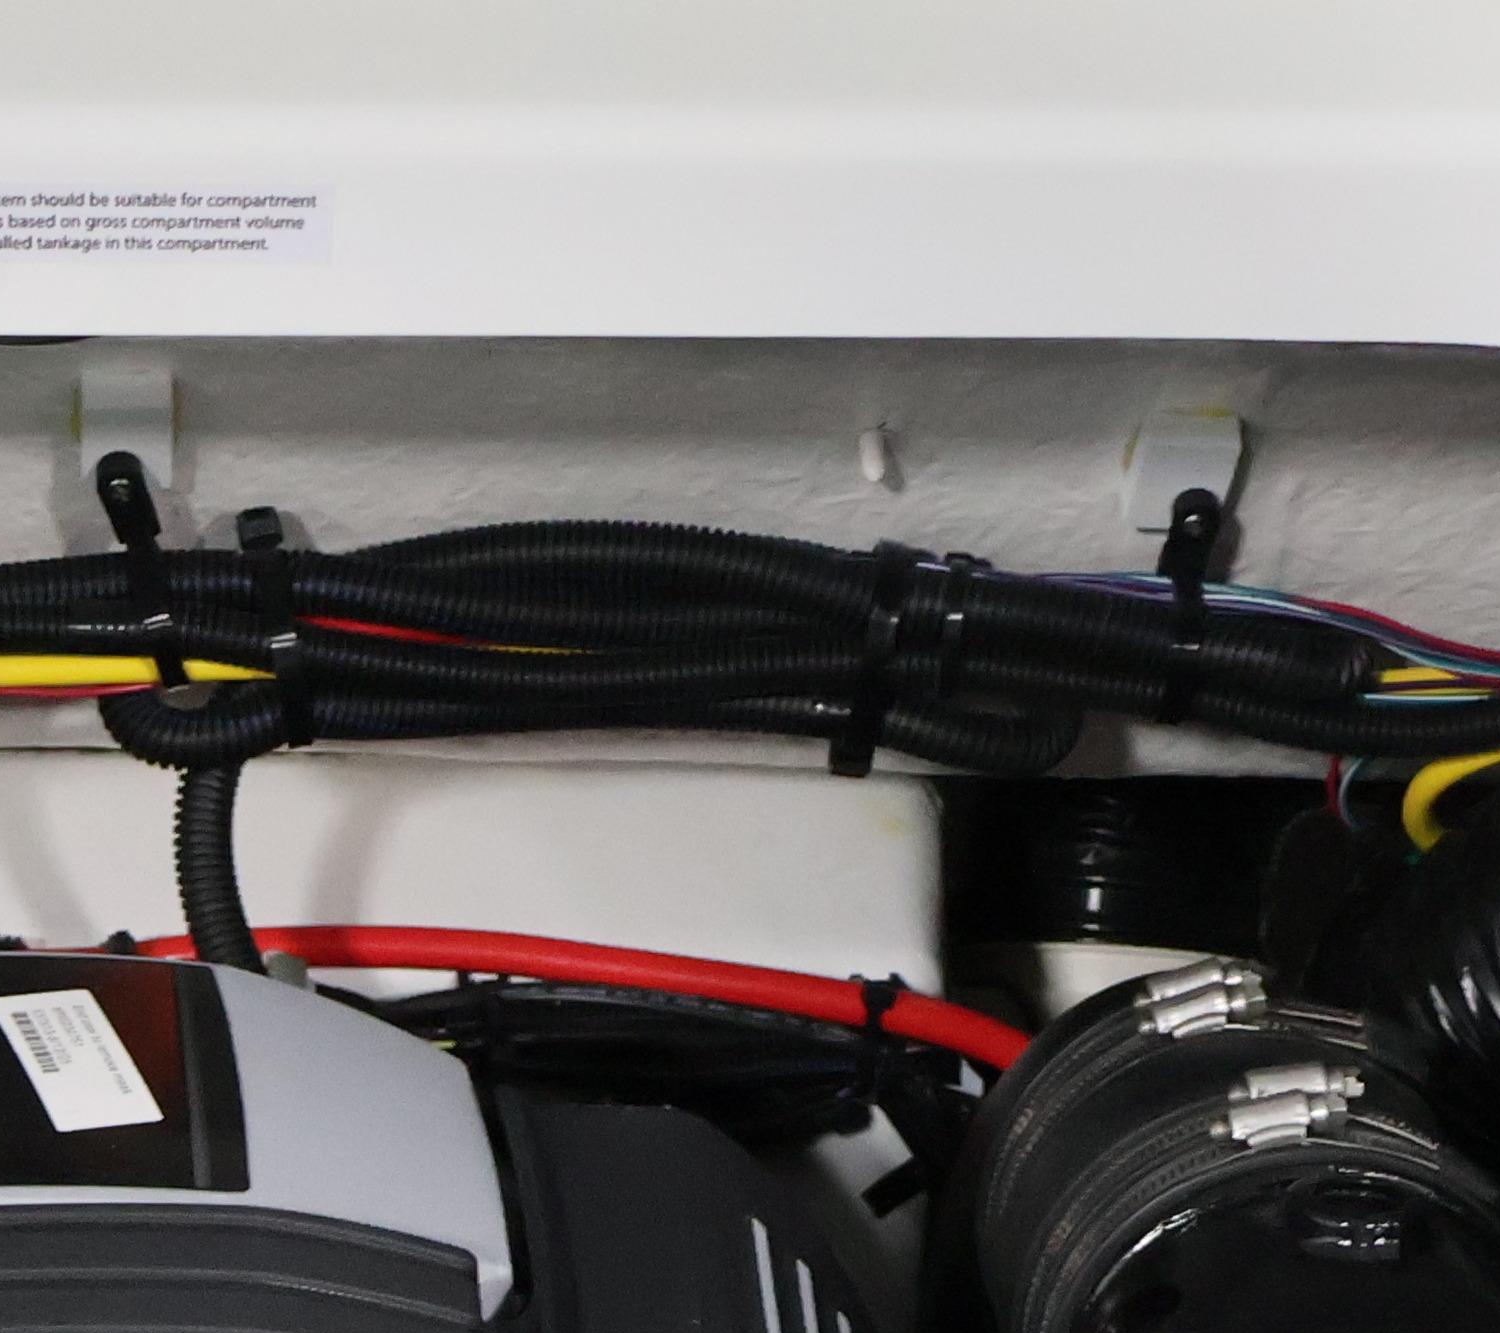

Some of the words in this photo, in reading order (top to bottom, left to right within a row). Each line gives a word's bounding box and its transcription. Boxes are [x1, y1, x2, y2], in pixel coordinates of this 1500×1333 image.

[31, 193, 85, 207] should
[89, 192, 109, 207] be
[114, 193, 177, 207] suitable
[181, 192, 203, 207] for
[207, 195, 316, 208] compartment
[8, 214, 56, 229] based
[60, 217, 81, 228] on
[85, 217, 127, 232] gross
[131, 217, 241, 229] compartment
[246, 217, 305, 229] volume
[36, 238, 101, 253] tankage
[105, 239, 120, 249] in
[124, 237, 153, 250] this
